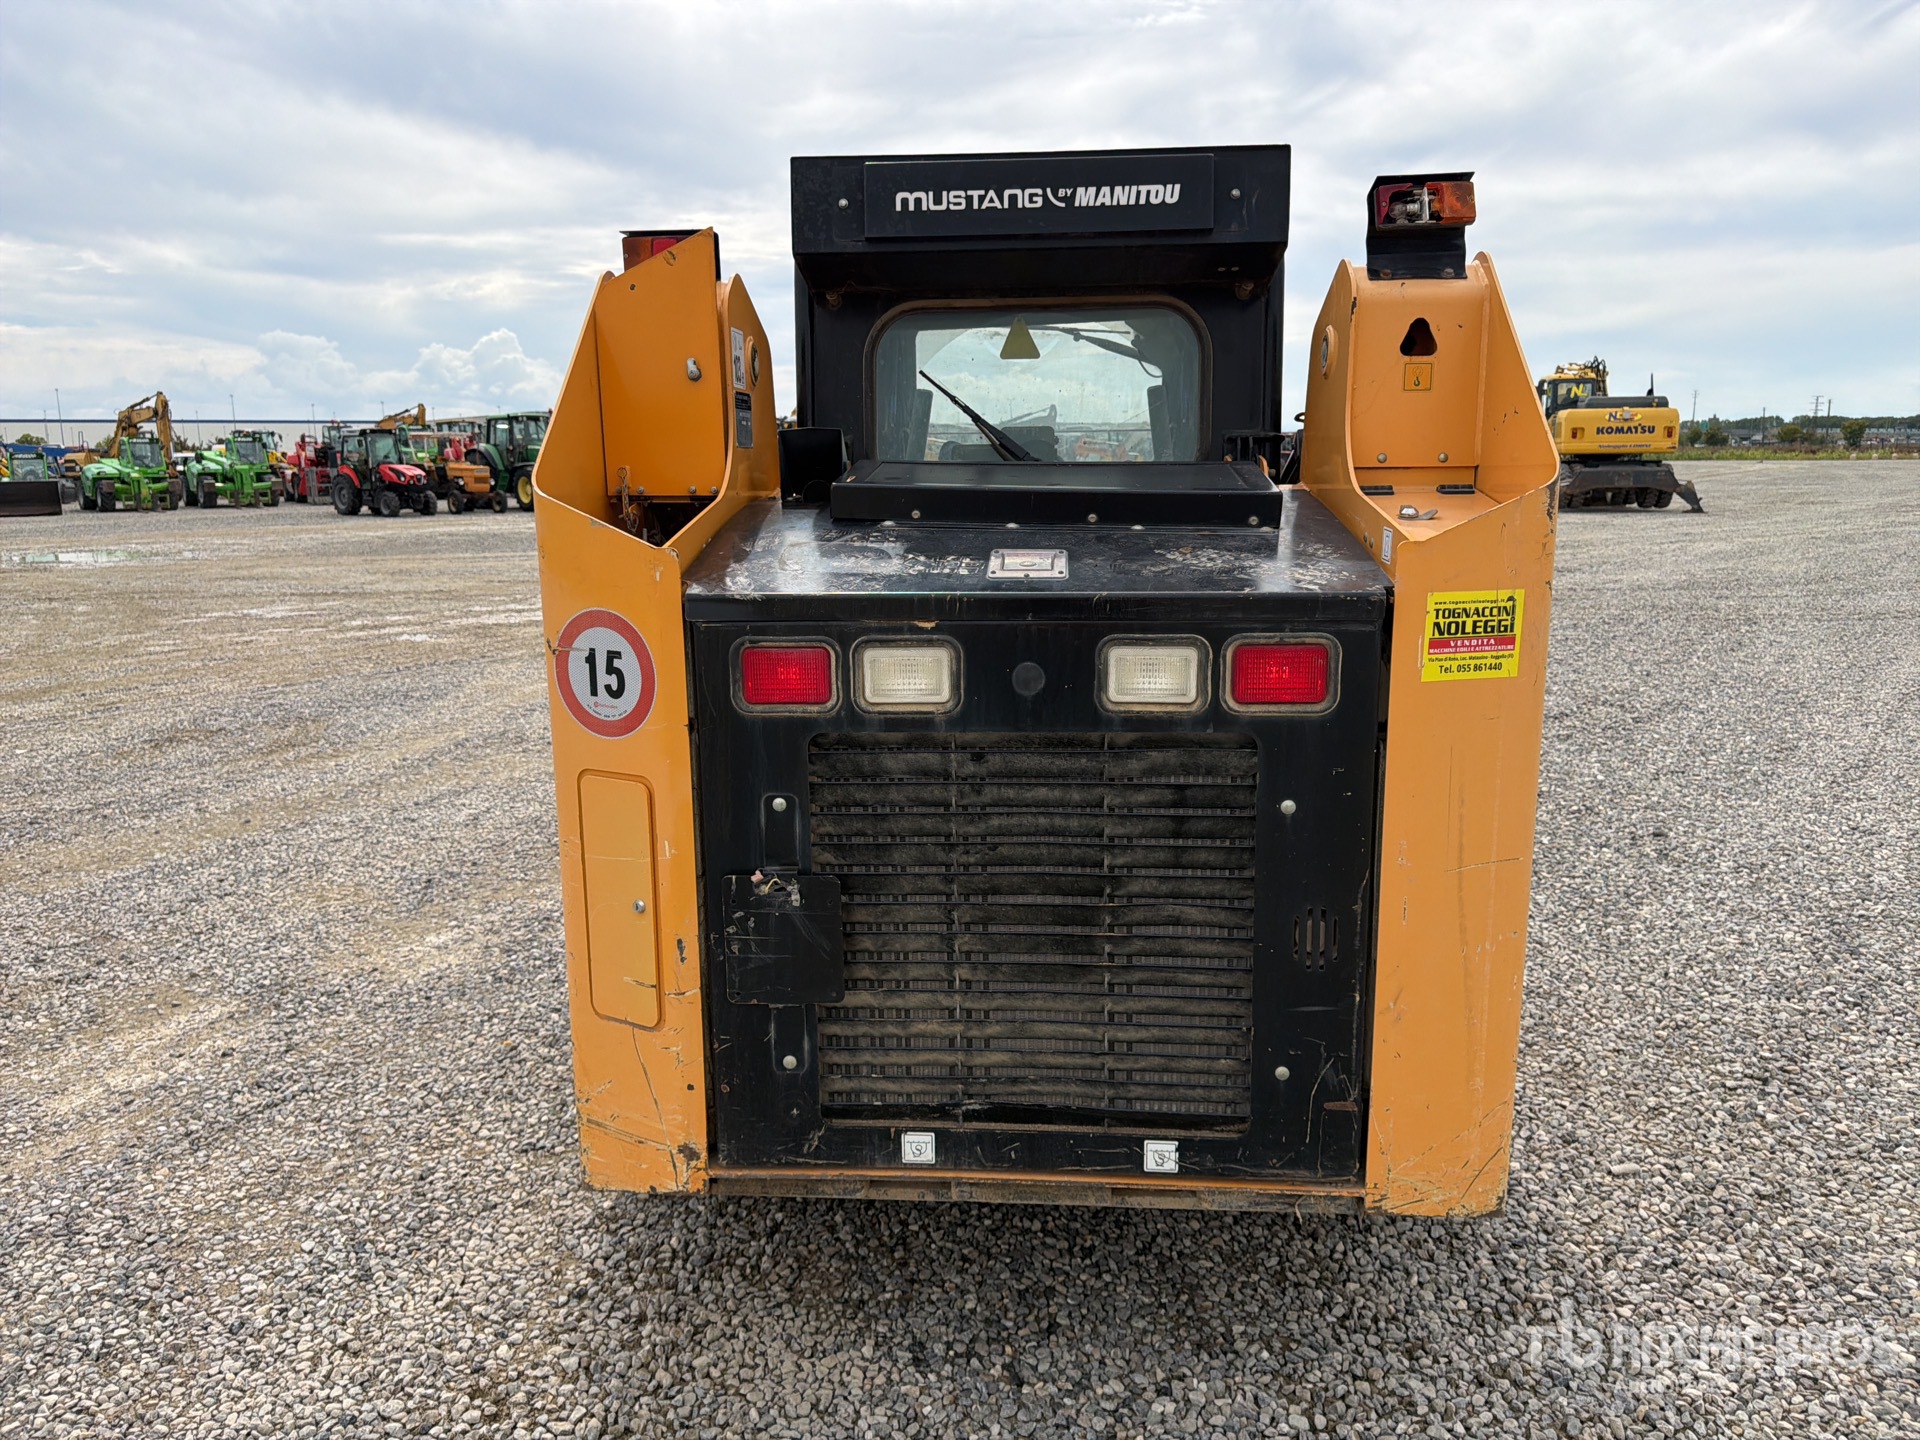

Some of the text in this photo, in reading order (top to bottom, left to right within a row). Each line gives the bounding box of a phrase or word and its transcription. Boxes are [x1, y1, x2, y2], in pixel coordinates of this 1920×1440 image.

[895, 183, 1182, 211] MUSTANG BY MANITOU
[1596, 424, 1656, 435] KOMATSU
[1450, 638, 1495, 647] VENDITA
[1475, 644, 1514, 652] ATTREZZATURE
[585, 648, 625, 699] 15
[1438, 662, 1502, 674] Tel. 055 861440
